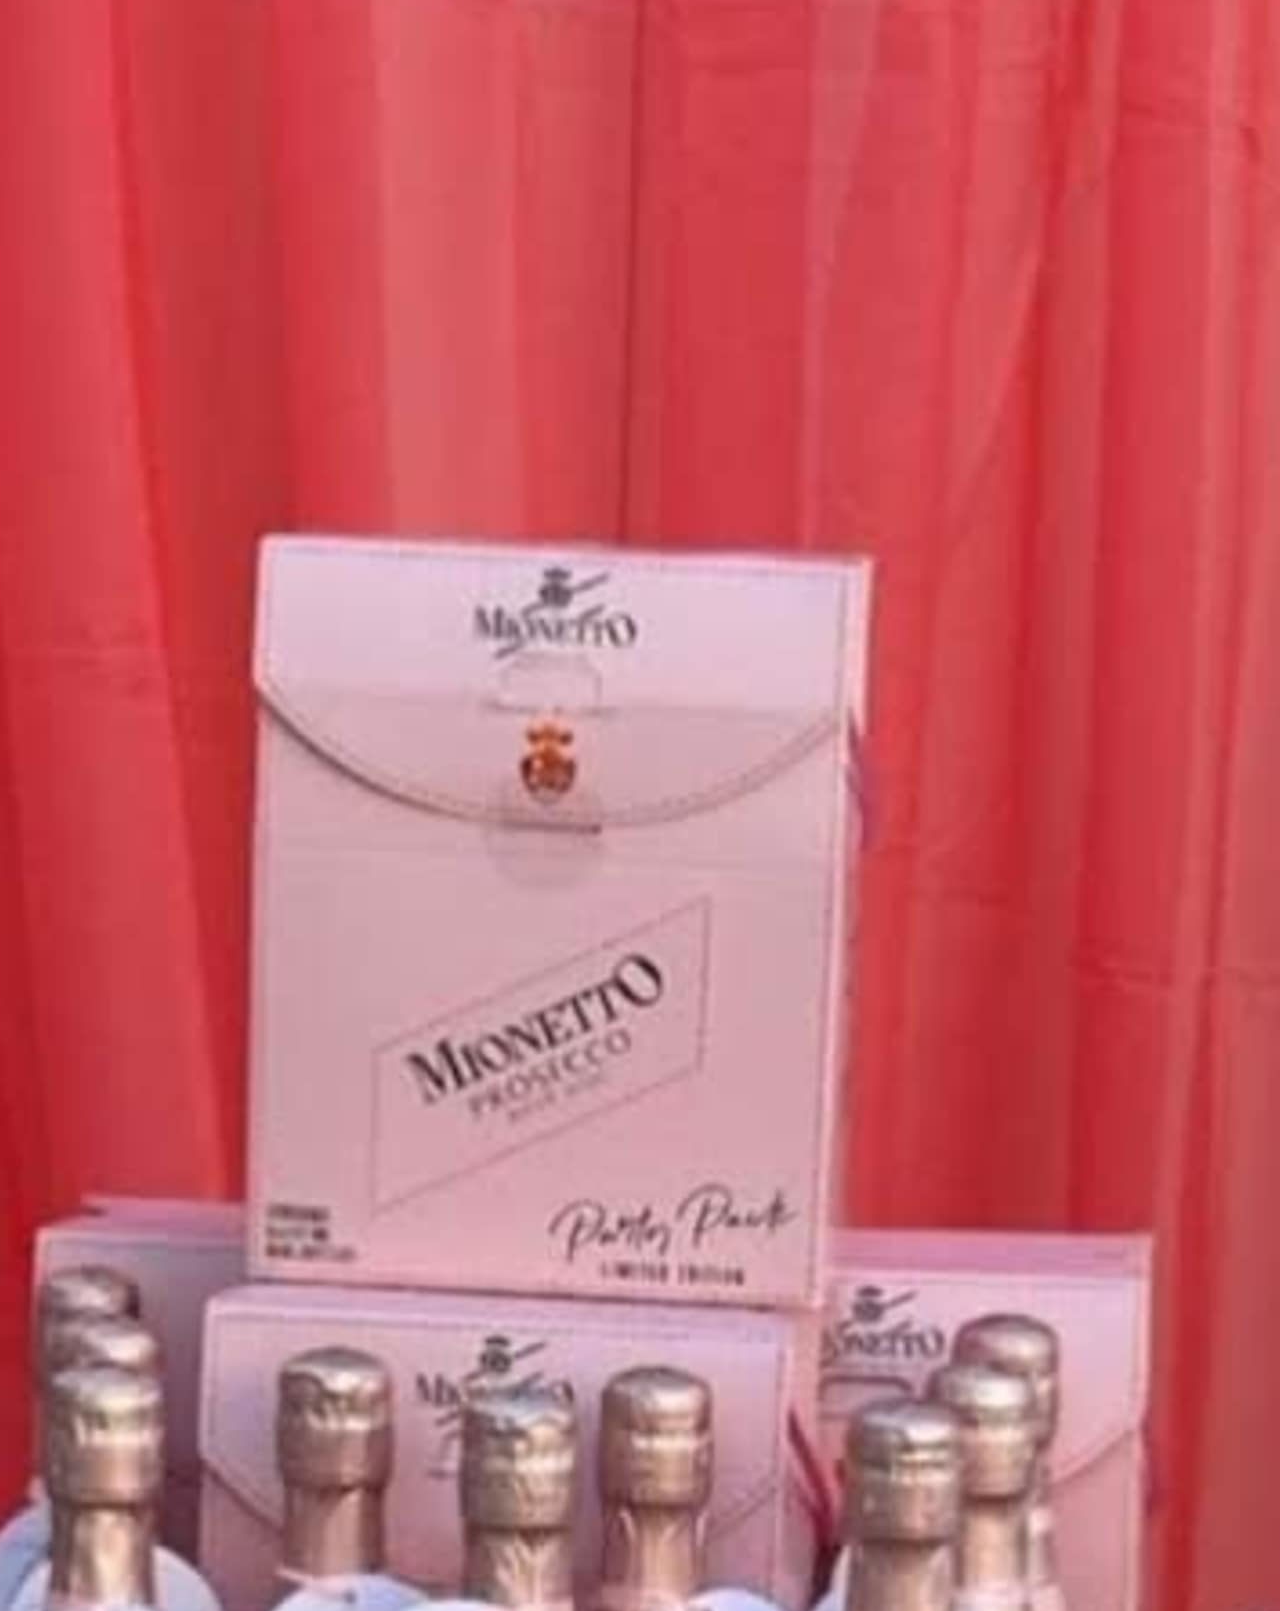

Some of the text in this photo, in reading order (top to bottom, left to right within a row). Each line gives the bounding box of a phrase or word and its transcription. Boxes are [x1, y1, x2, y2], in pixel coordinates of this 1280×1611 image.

[475, 603, 637, 652] MIONETTO
[406, 952, 664, 1105] MIONETTO
[469, 1027, 632, 1121] PROSECCO
[548, 1181, 802, 1263] Party Pack
